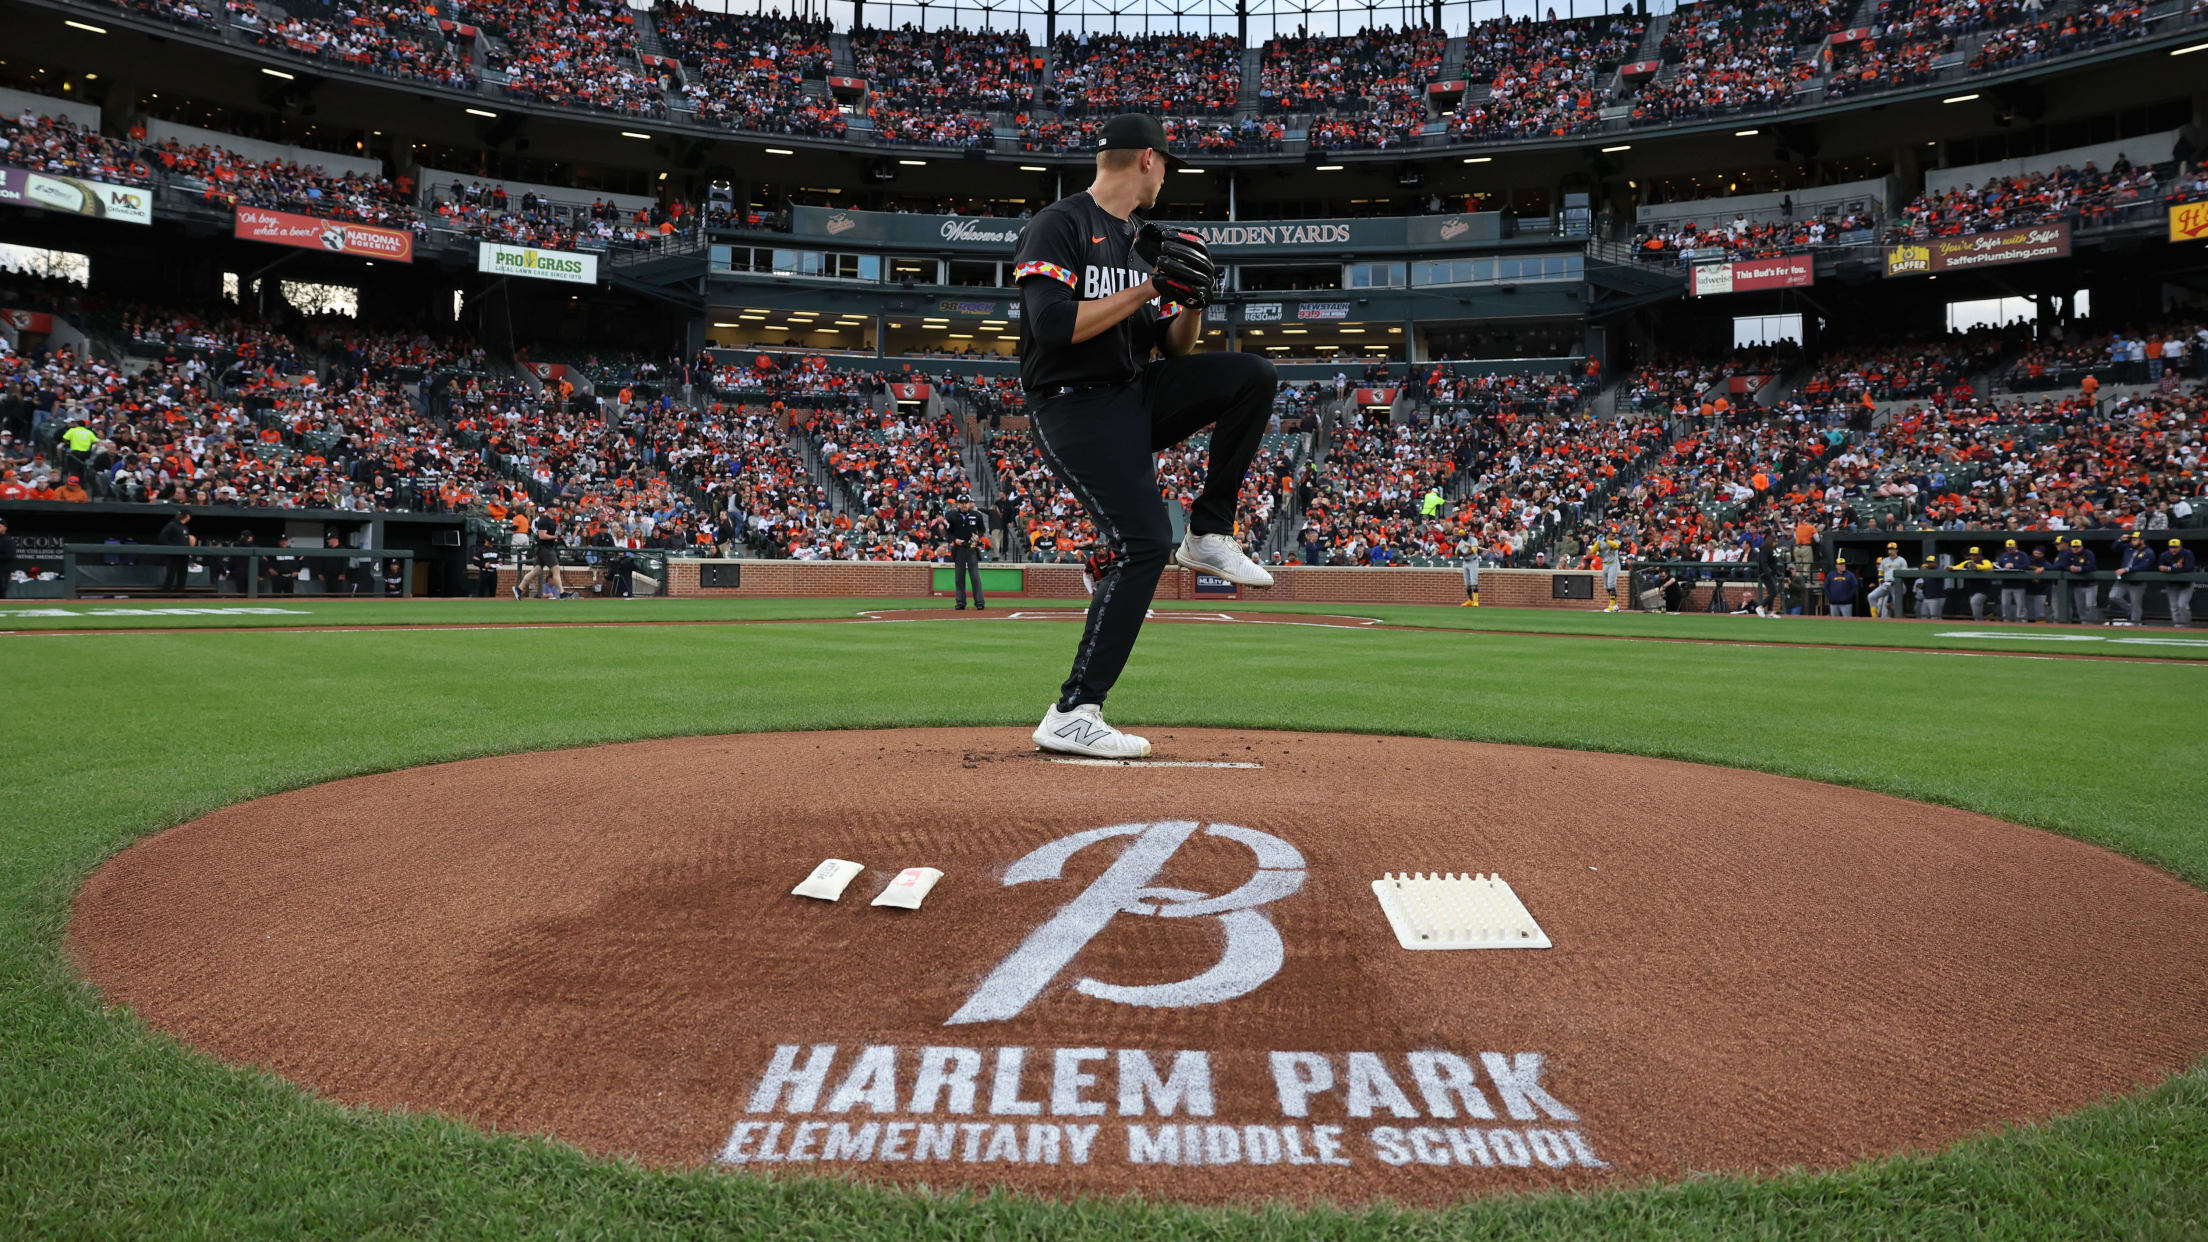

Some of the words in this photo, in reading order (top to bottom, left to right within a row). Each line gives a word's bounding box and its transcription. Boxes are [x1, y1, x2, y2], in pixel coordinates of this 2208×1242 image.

[0, 189, 21, 199] OM
[253, 225, 279, 236] what
[280, 228, 288, 236] a
[347, 230, 401, 247] NATIONAL
[940, 219, 1004, 241] Welcome
[1004, 230, 1019, 242] to
[1187, 226, 1277, 245] AMDEN
[1278, 224, 1350, 243] YARDS
[351, 239, 398, 252] BOHEMIAN
[1940, 241, 1974, 256] You're
[1973, 237, 2001, 251] Safer
[2002, 234, 2027, 246] with
[2025, 229, 2060, 245] Saffer
[495, 252, 524, 267] PRO
[537, 257, 582, 273] GRASS
[1946, 246, 2058, 267] SafferPlumbing.com
[1736, 270, 1752, 279] This
[1753, 268, 1775, 277] Bud's
[1776, 266, 1788, 275] For
[1891, 260, 1927, 273] SAFFER
[1084, 264, 1161, 310] BALTIM
[957, 302, 995, 312] ROCK
[1245, 303, 1282, 314] ESPN
[1298, 310, 1320, 319] 93.9
[1299, 303, 1350, 311] NEWSTALK
[944, 821, 1307, 1026] B
[745, 1044, 1216, 1118] HARLEM
[1268, 1047, 1581, 1123] PARK
[718, 1120, 1100, 1166] ELEMENTARY
[1127, 1123, 1351, 1167] MIDDLE
[1369, 1125, 1612, 1169] SCHOOL
